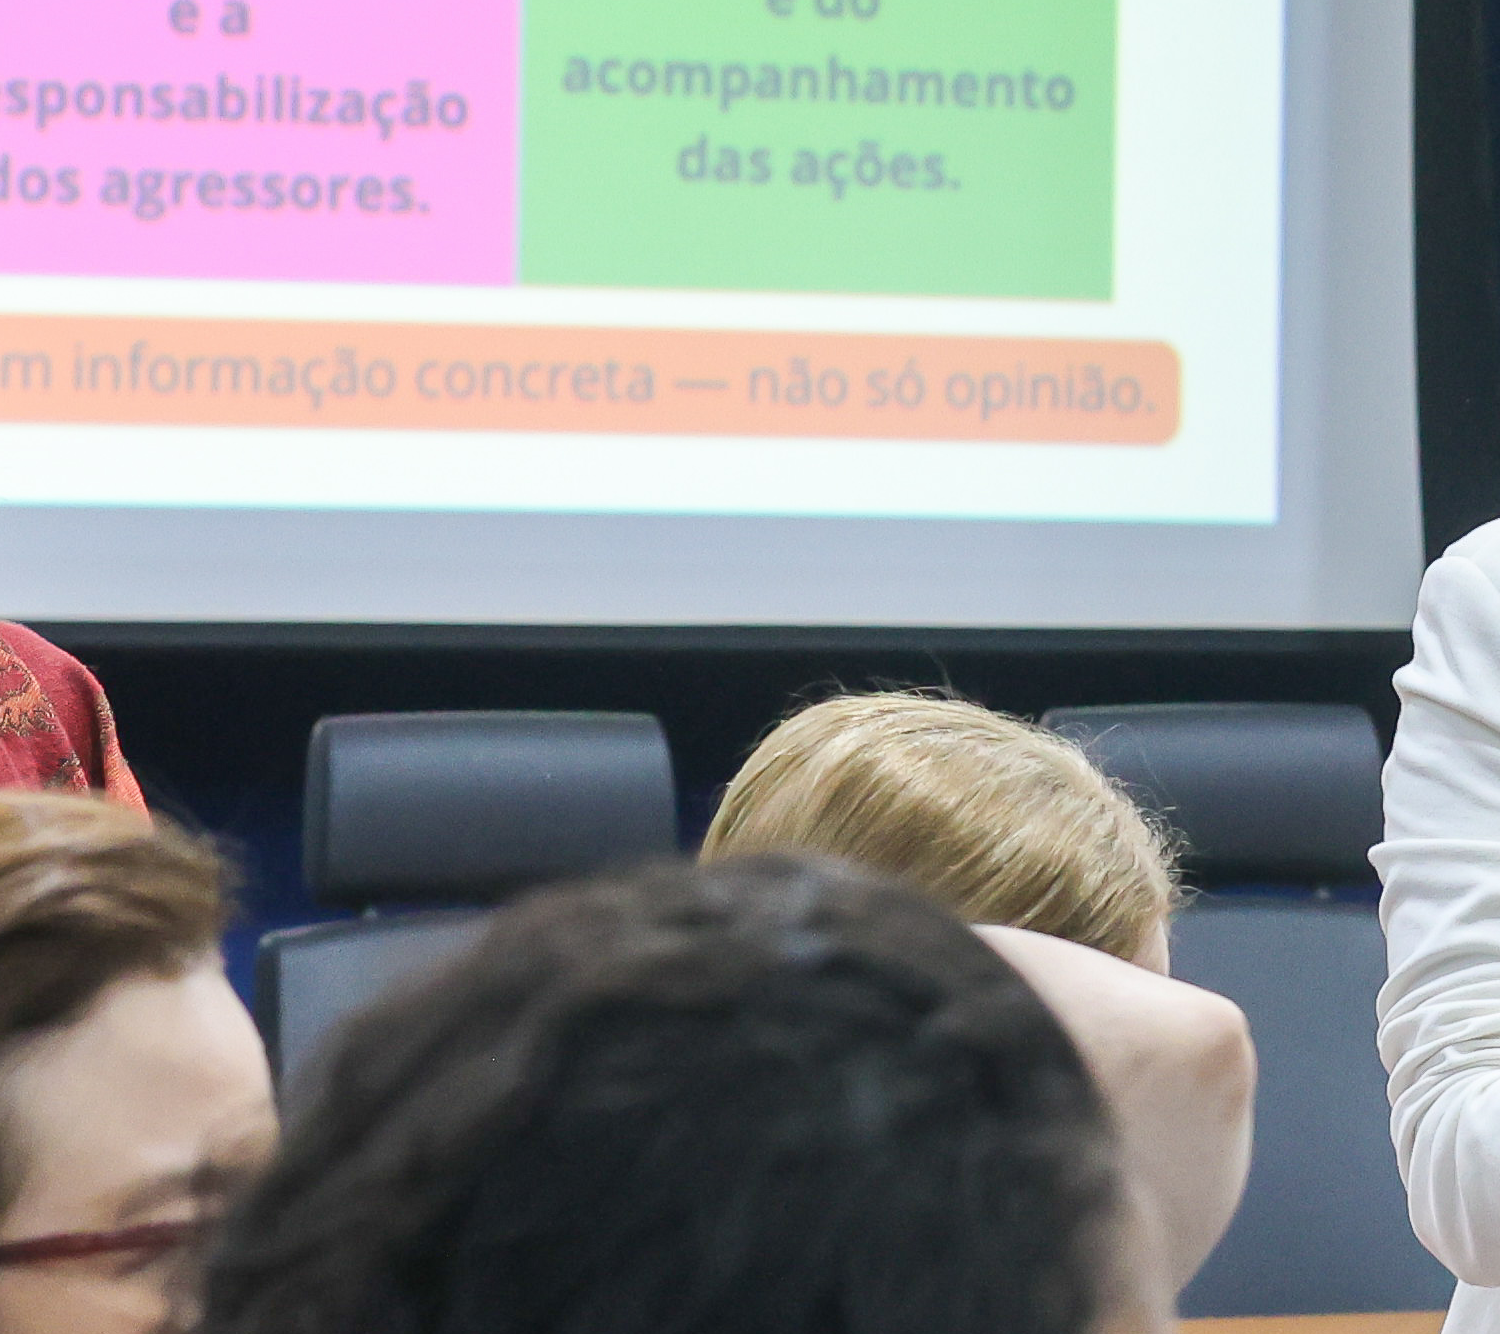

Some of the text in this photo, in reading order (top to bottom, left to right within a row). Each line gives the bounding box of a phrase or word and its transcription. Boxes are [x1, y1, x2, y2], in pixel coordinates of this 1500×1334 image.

[219, 0, 251, 37] a
[561, 55, 1076, 112] acompanhamento
[100, 163, 429, 220] agressores.
[676, 134, 961, 200] das ações.
[72, 339, 397, 405] informação
[414, 359, 656, 404] concreta
[748, 357, 849, 407] não
[866, 358, 927, 409] só
[944, 364, 1158, 424] opinião.
